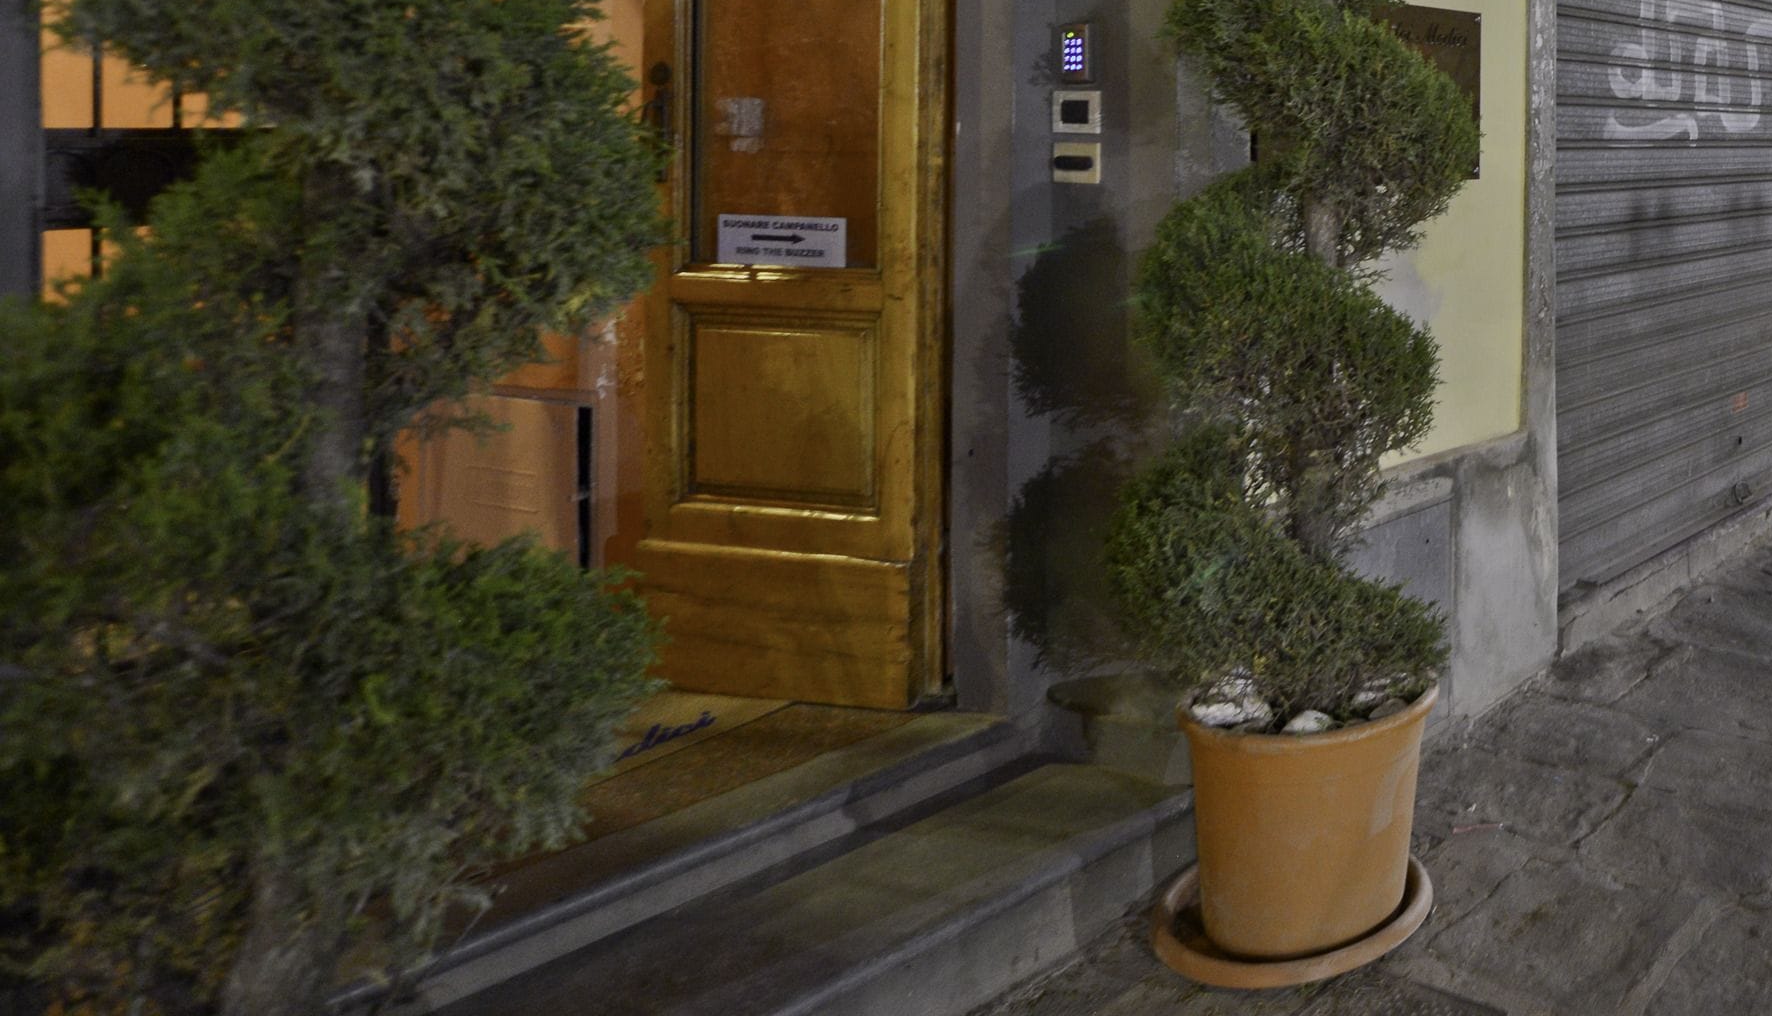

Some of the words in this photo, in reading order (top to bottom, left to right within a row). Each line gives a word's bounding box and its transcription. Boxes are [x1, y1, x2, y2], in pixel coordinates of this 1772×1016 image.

[722, 219, 770, 230] SUONARE
[772, 221, 839, 233] CAMPANELLO
[736, 246, 760, 256] RING
[762, 247, 783, 257] THE
[784, 248, 825, 258] BUZZER
